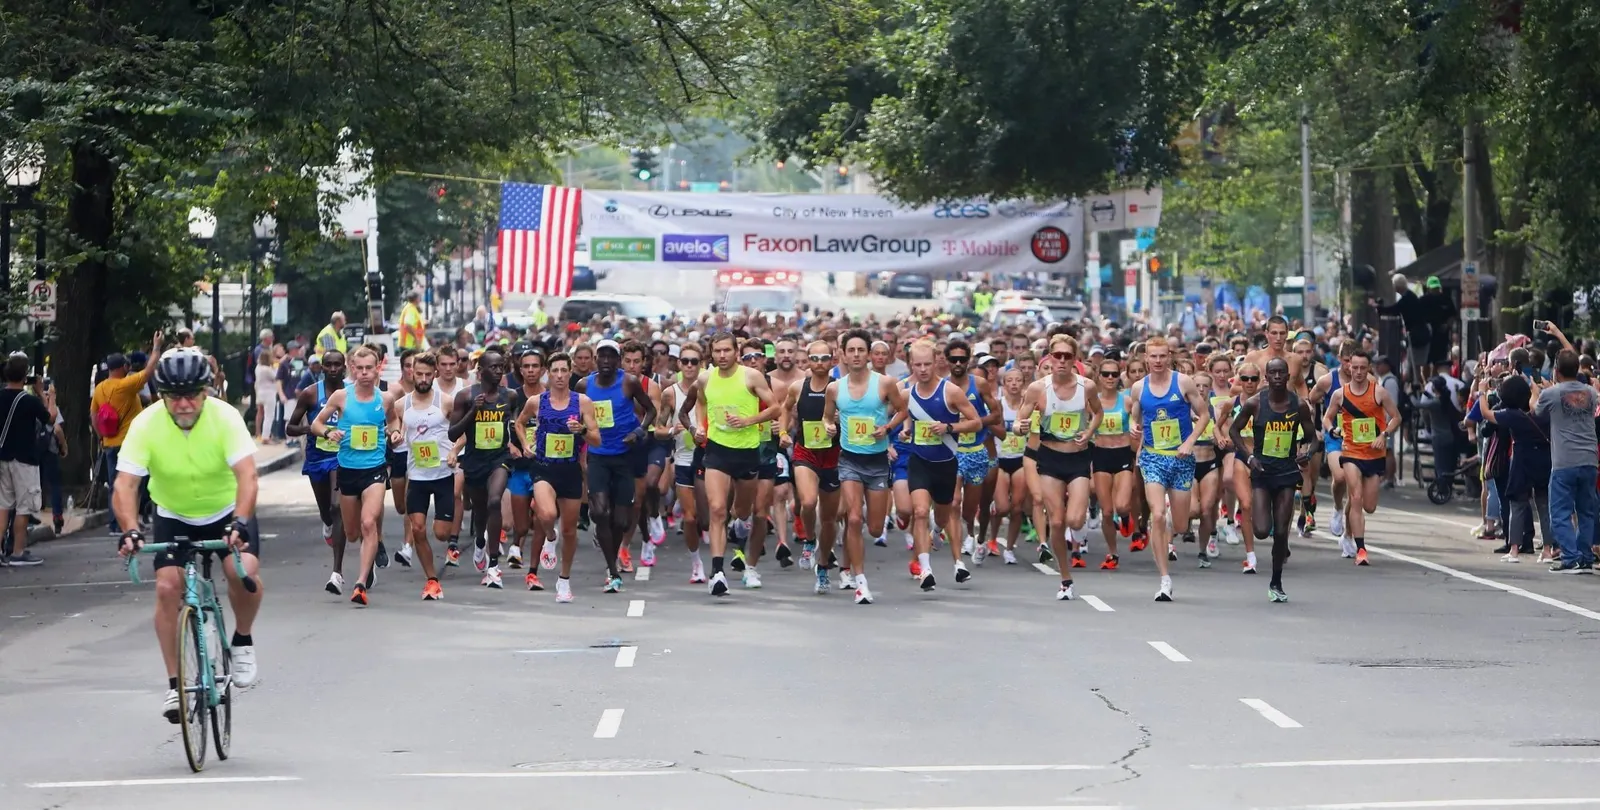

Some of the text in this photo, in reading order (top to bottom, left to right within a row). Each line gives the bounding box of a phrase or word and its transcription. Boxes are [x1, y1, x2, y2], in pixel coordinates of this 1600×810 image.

[672, 207, 733, 217] LEXUS
[772, 206, 893, 219] City of New Haven
[934, 203, 990, 218] aces
[1035, 231, 1060, 240] TOWN
[664, 239, 711, 254] avelo
[743, 233, 932, 257] FaxonLawGroup
[960, 239, 1020, 257] Mobile
[1037, 240, 1062, 249] FAIR
[1041, 249, 1062, 259] TIRE
[474, 410, 505, 421] ARMY
[855, 422, 867, 435] 20
[1060, 416, 1071, 429] 19
[1265, 420, 1295, 432] ARMY
[1359, 423, 1369, 433] 49
[362, 431, 368, 443] 6
[484, 427, 496, 439] 10
[1160, 425, 1171, 438] 77
[554, 439, 566, 452] 23
[1275, 436, 1281, 448] 1
[419, 446, 431, 458] 50
